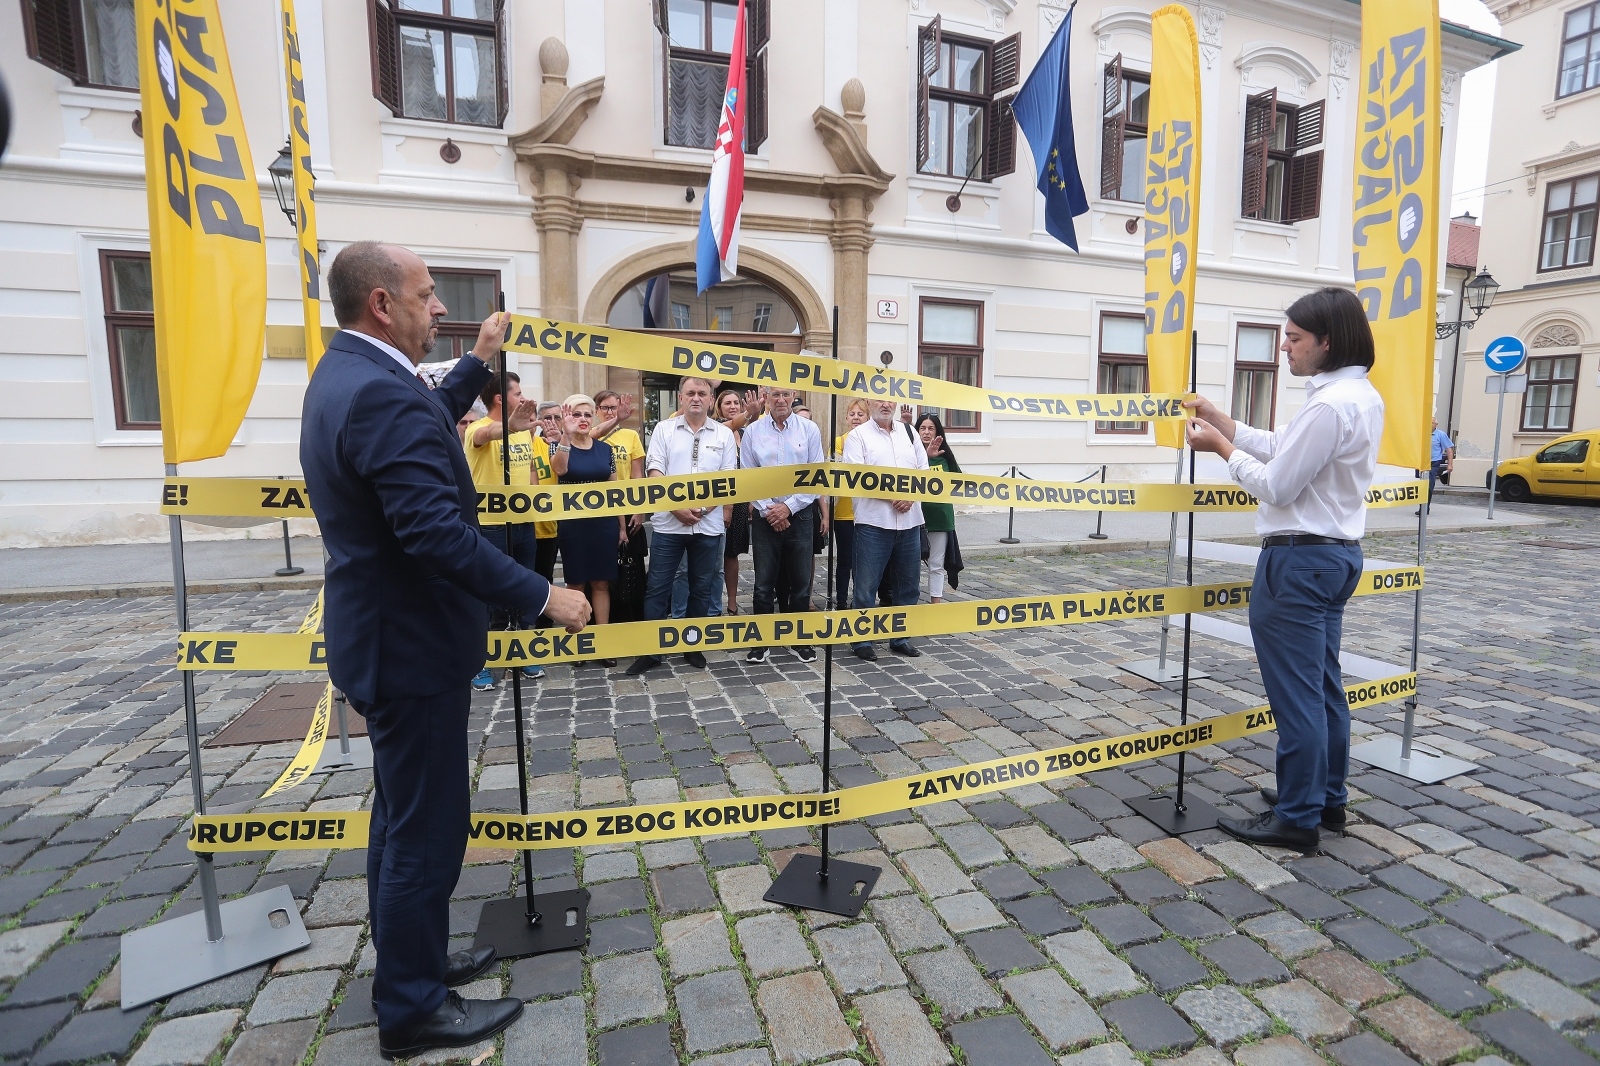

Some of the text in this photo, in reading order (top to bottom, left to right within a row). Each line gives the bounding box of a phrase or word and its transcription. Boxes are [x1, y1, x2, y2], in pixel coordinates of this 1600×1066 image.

[153, 0, 192, 230] DO
[174, 0, 261, 243] PLJA
[884, 302, 891, 312] 2
[671, 346, 778, 381] DOSTA
[789, 361, 924, 400] PLJAČKE
[988, 394, 1073, 416] DOSTA
[1078, 394, 1184, 417] PLJAČKE
[476, 492, 553, 514] ZBOG
[562, 477, 737, 512] KORUPCIJE!
[793, 469, 944, 496] ZATVORENO
[950, 479, 1010, 501] ZBOG
[1015, 484, 1136, 506] KORUPCIJE!
[486, 630, 596, 662] JAČKE
[658, 621, 763, 649] DOSTA
[774, 610, 907, 641] PLJAČKE
[976, 602, 1055, 626] DOSTA
[1062, 591, 1165, 618] PLJAČKE
[1373, 571, 1421, 590] DOSTA
[469, 818, 588, 842] VORENO
[596, 810, 676, 836] ZBOG
[684, 797, 841, 829] KORUPCIJE!
[907, 758, 1041, 800] ZATVORENO
[1044, 747, 1101, 773] ZBOG
[1106, 724, 1213, 760] KORUPCIJE!
[1345, 685, 1378, 704] BOG
